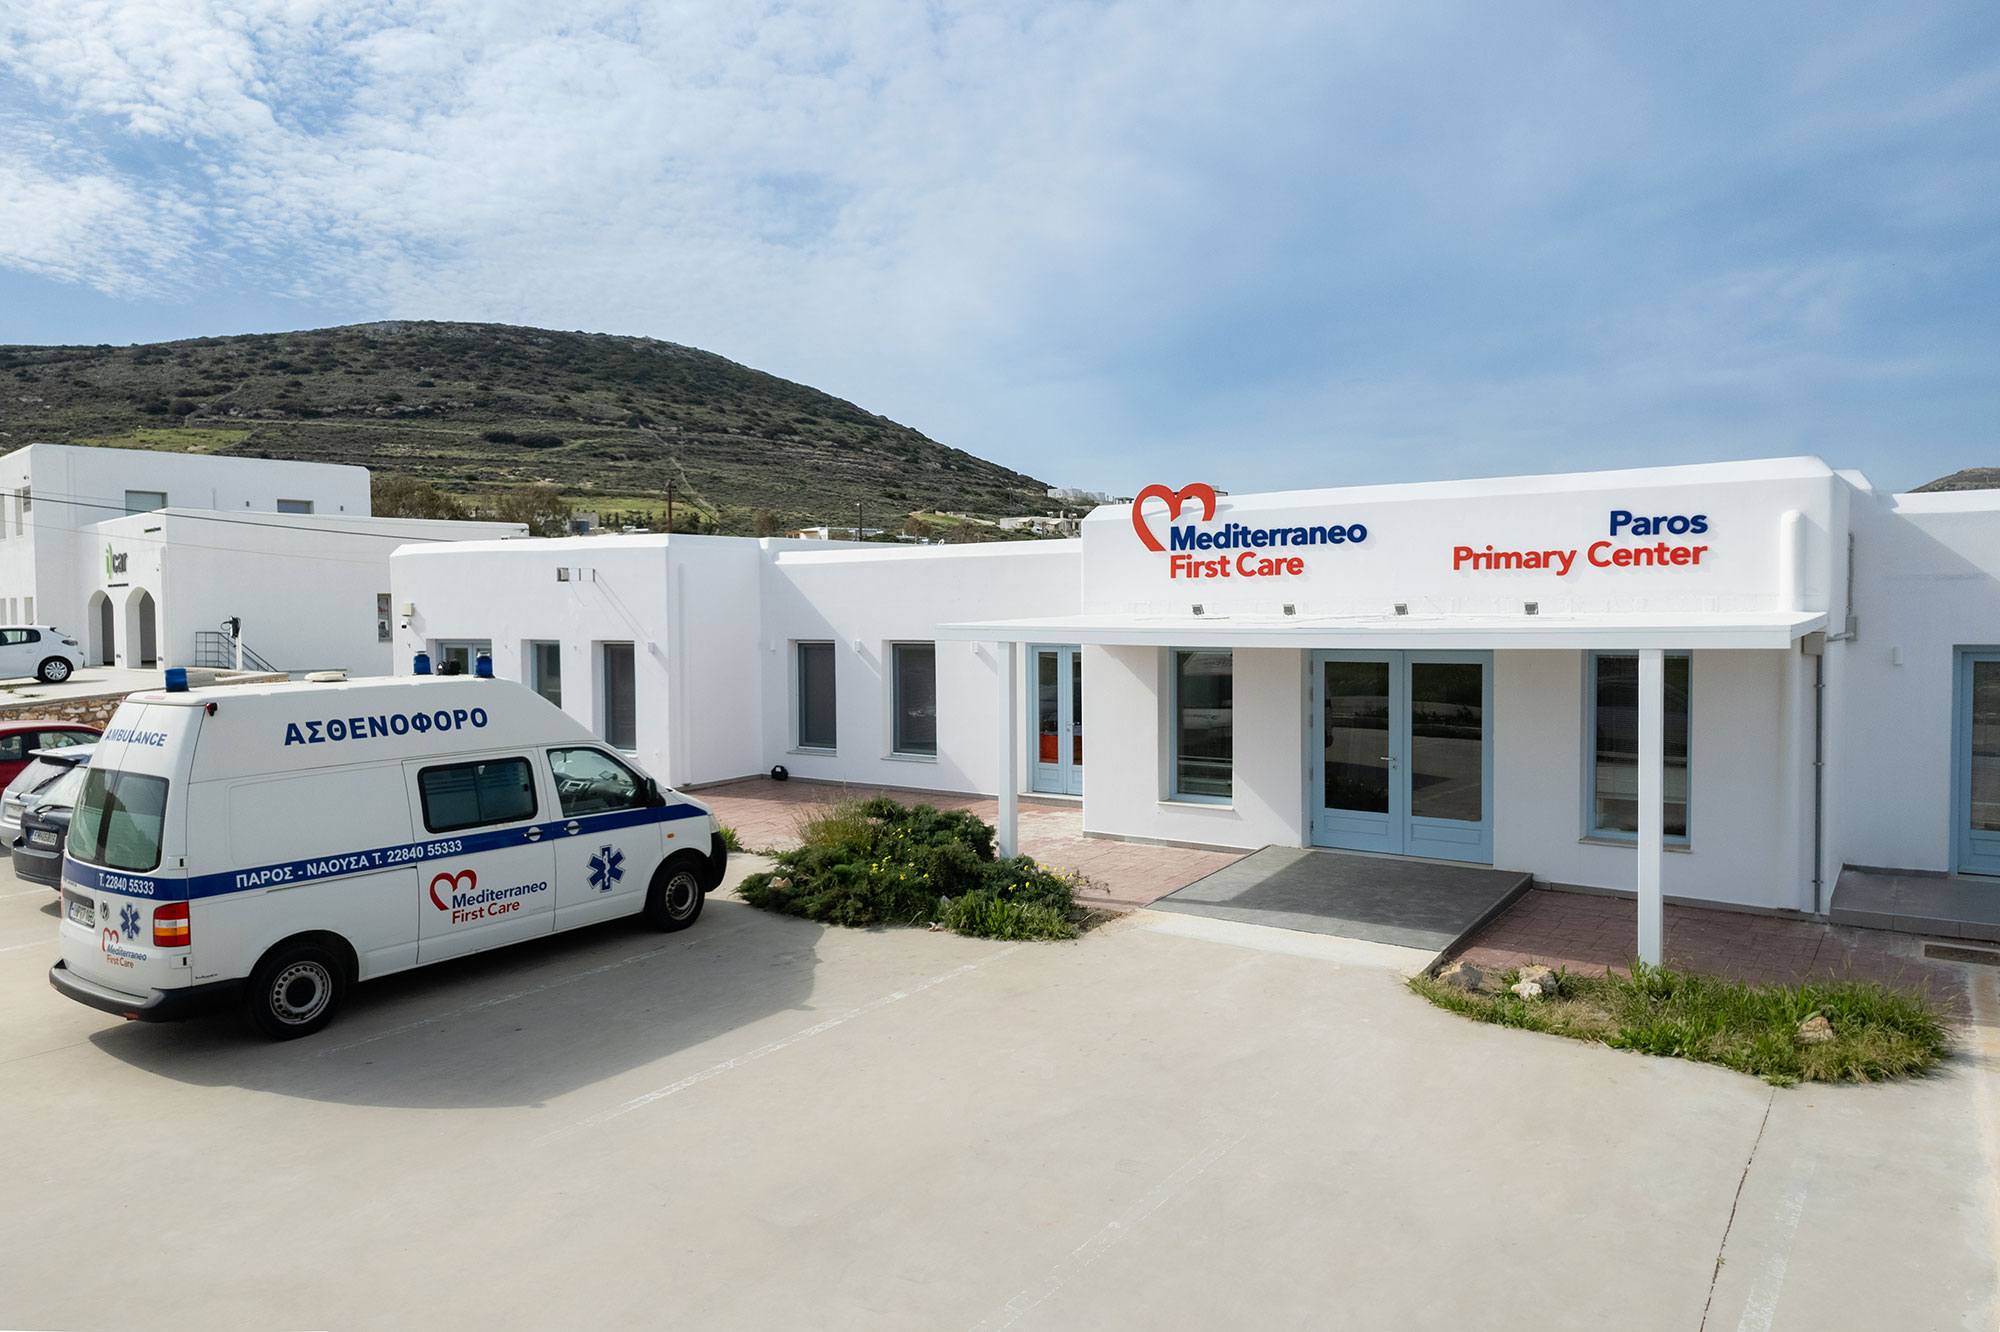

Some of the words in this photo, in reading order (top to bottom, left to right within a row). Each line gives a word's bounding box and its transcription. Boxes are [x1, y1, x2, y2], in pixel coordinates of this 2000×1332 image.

[1610, 510, 1709, 536] Paros
[1170, 523, 1368, 551] Mediterraneo
[1170, 554, 1230, 579] First
[1236, 551, 1304, 577] Care
[1453, 545, 1577, 576] Primary
[1587, 541, 1708, 567] Center
[105, 728, 168, 747] AMBULANCE
[284, 707, 488, 746] ΑΣΘΕΝΟΦΟΡΟ
[235, 867, 294, 888] ΠΑΡΟΣ
[306, 855, 369, 877] ΝΑΟΥΣΑ
[387, 846, 424, 863] 22840
[427, 840, 463, 857] 55333
[105, 874, 127, 891] 22840
[128, 879, 155, 895] 55333
[452, 881, 548, 909] Mediterraneo
[452, 907, 485, 924] First
[487, 901, 520, 916] Care
[106, 944, 147, 961] Mediterraneo
[106, 954, 119, 966] First
[119, 957, 134, 969] Care
